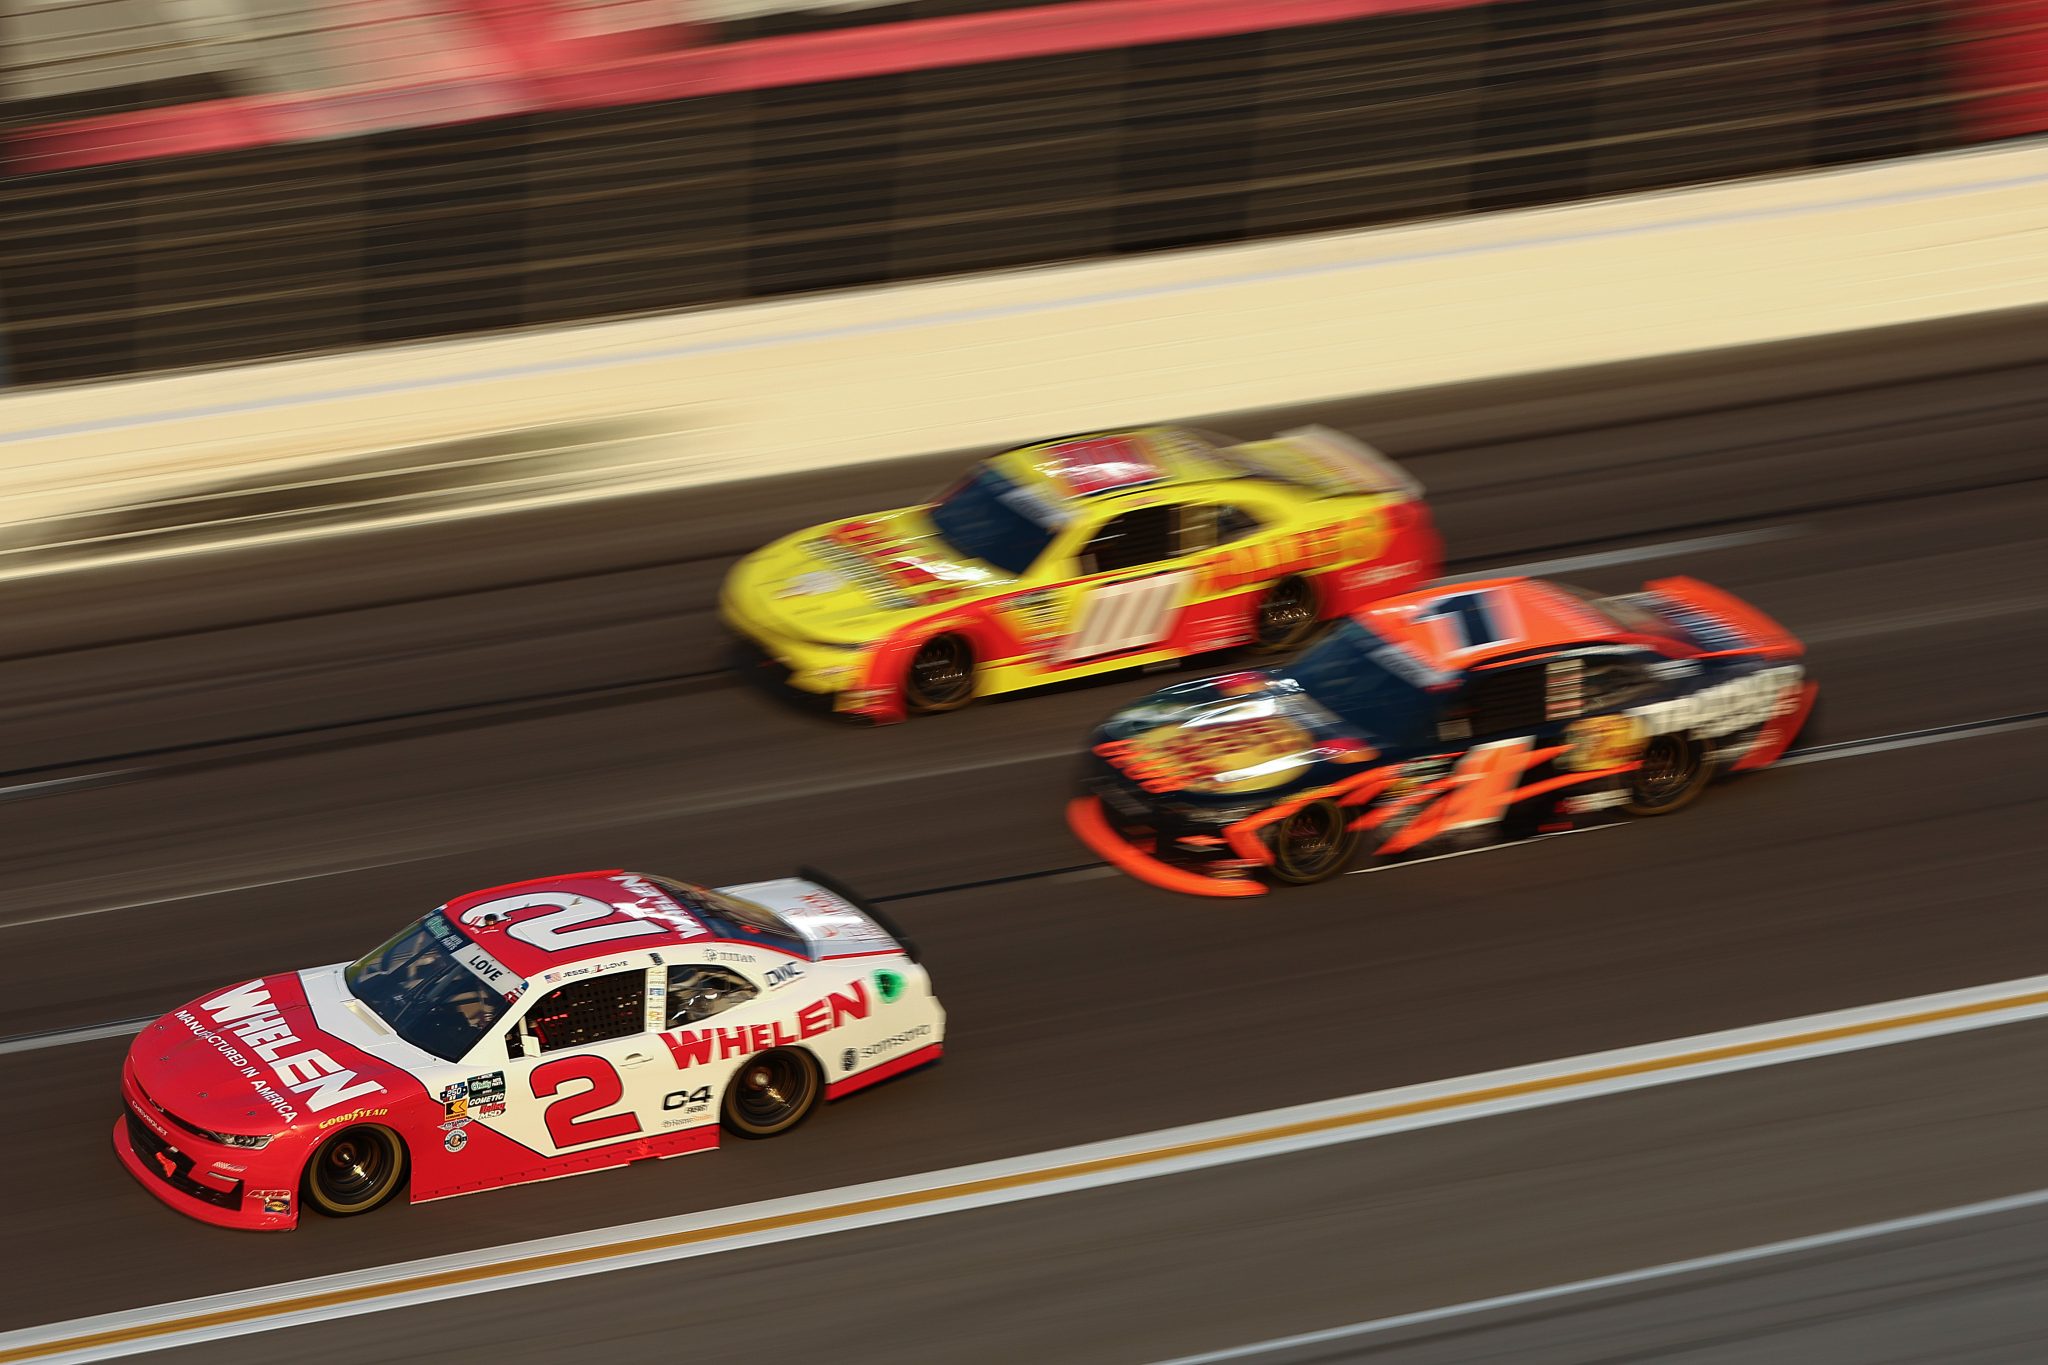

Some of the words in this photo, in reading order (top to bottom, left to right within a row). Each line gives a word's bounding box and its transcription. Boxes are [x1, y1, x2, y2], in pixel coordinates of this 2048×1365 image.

[459, 891, 670, 952] 2
[469, 955, 504, 982] LOVE
[200, 979, 384, 1113] WHELEN
[658, 977, 871, 1070] WHELEN
[174, 1009, 248, 1067] MANUFACTURED
[240, 1066, 260, 1078] IN
[250, 1080, 298, 1123] AMERICA
[132, 1100, 169, 1137] CHEVROLET
[319, 1107, 388, 1129] GOODYEAR
[469, 1093, 504, 1106] COMETIC
[528, 1053, 644, 1150] 2
[663, 1084, 714, 1111] C4
